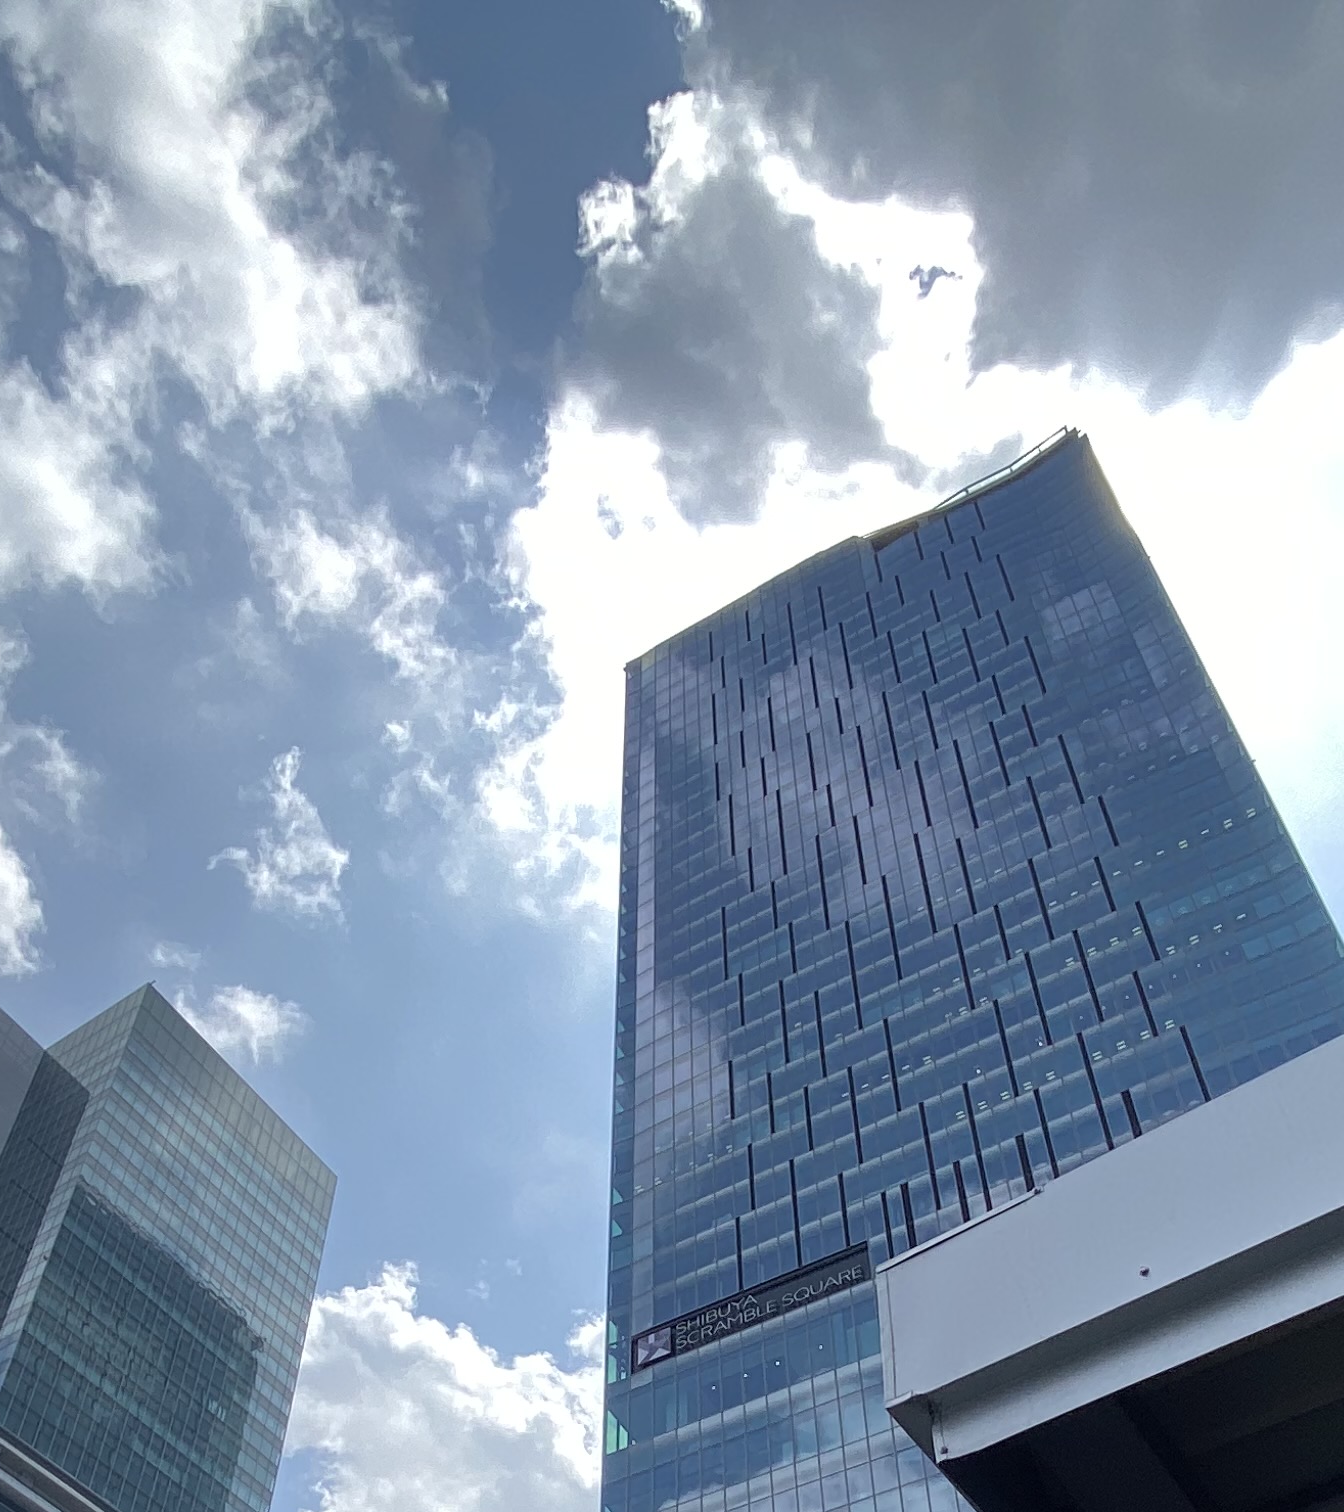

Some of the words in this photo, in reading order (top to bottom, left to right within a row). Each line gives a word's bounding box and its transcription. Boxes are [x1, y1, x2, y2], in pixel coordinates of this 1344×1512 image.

[675, 1300, 777, 1349] SCRAMBLE
[782, 1264, 864, 1307] SQUARE
[676, 1294, 758, 1335] SHIBUYA
